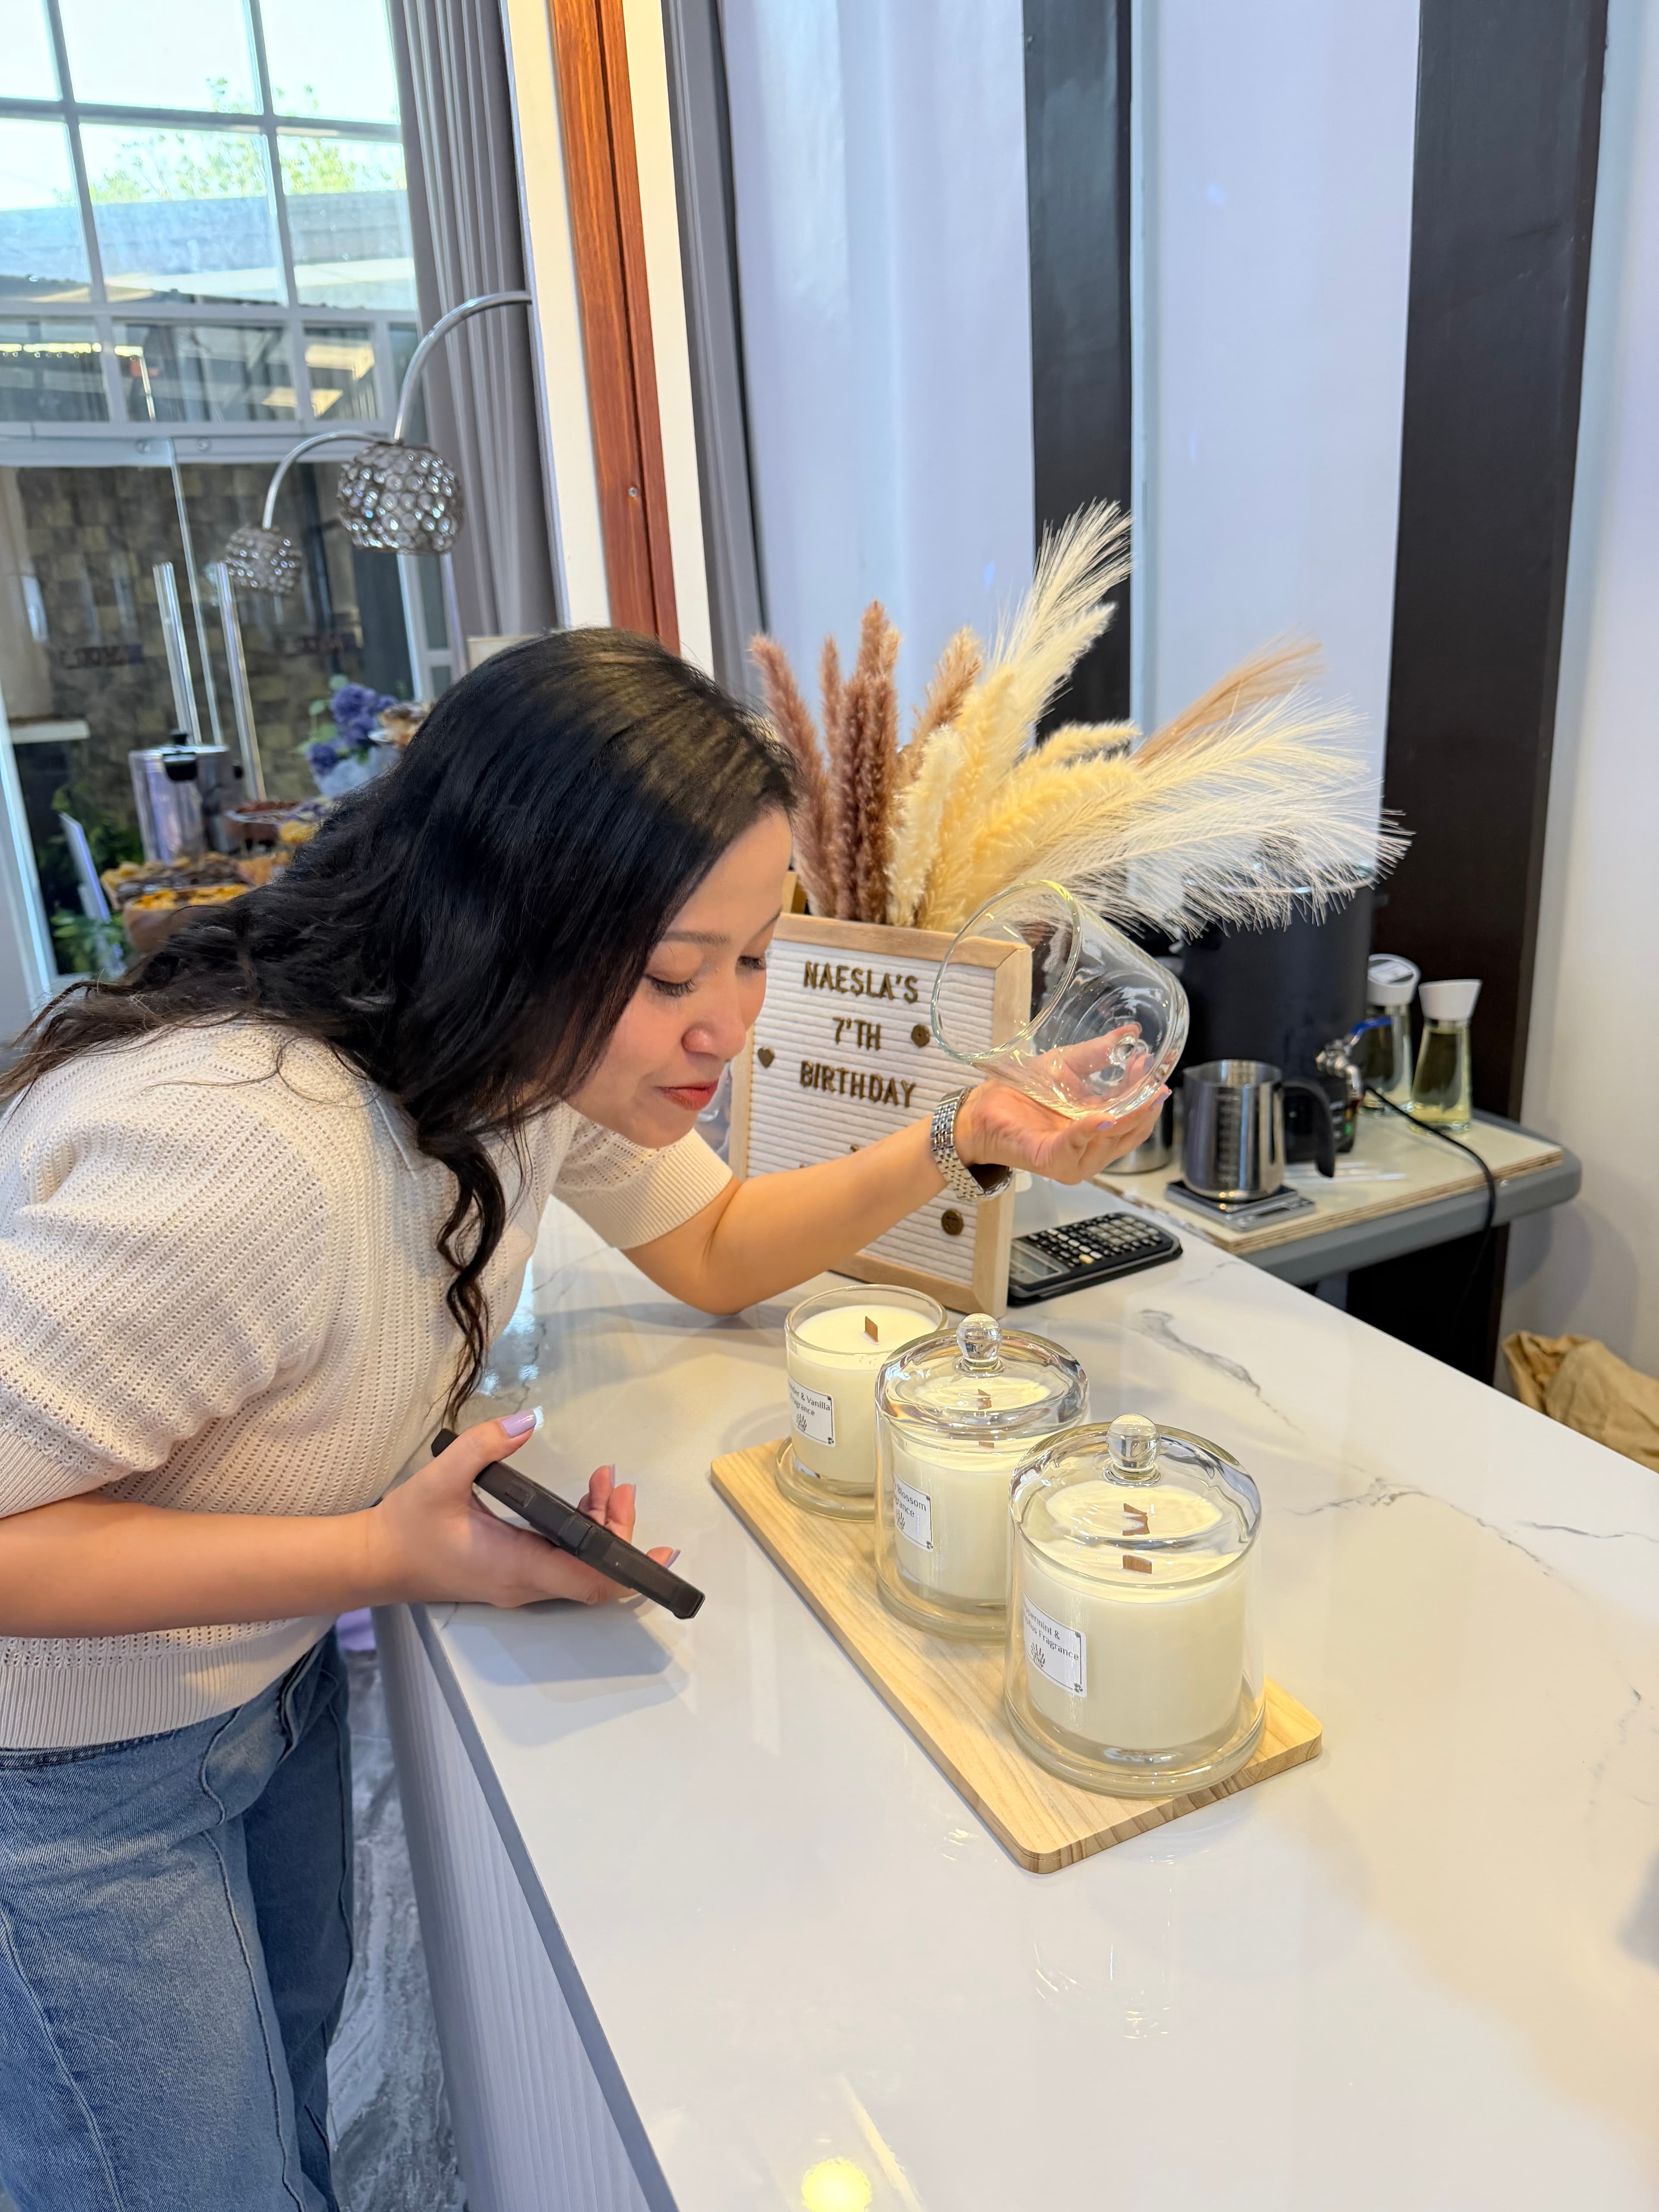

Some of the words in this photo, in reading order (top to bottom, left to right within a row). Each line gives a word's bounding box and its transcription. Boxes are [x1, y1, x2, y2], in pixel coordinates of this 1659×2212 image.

[803, 961, 918, 1004] NAESLA'S
[832, 1017, 881, 1050] 7'TH
[800, 1060, 916, 1108] BIRTHDAY
[806, 1395, 830, 1411] Vanilla
[897, 1484, 926, 1511] Blossom
[1039, 1630, 1079, 1660] Fragrance
[1054, 1630, 1060, 1640] &
